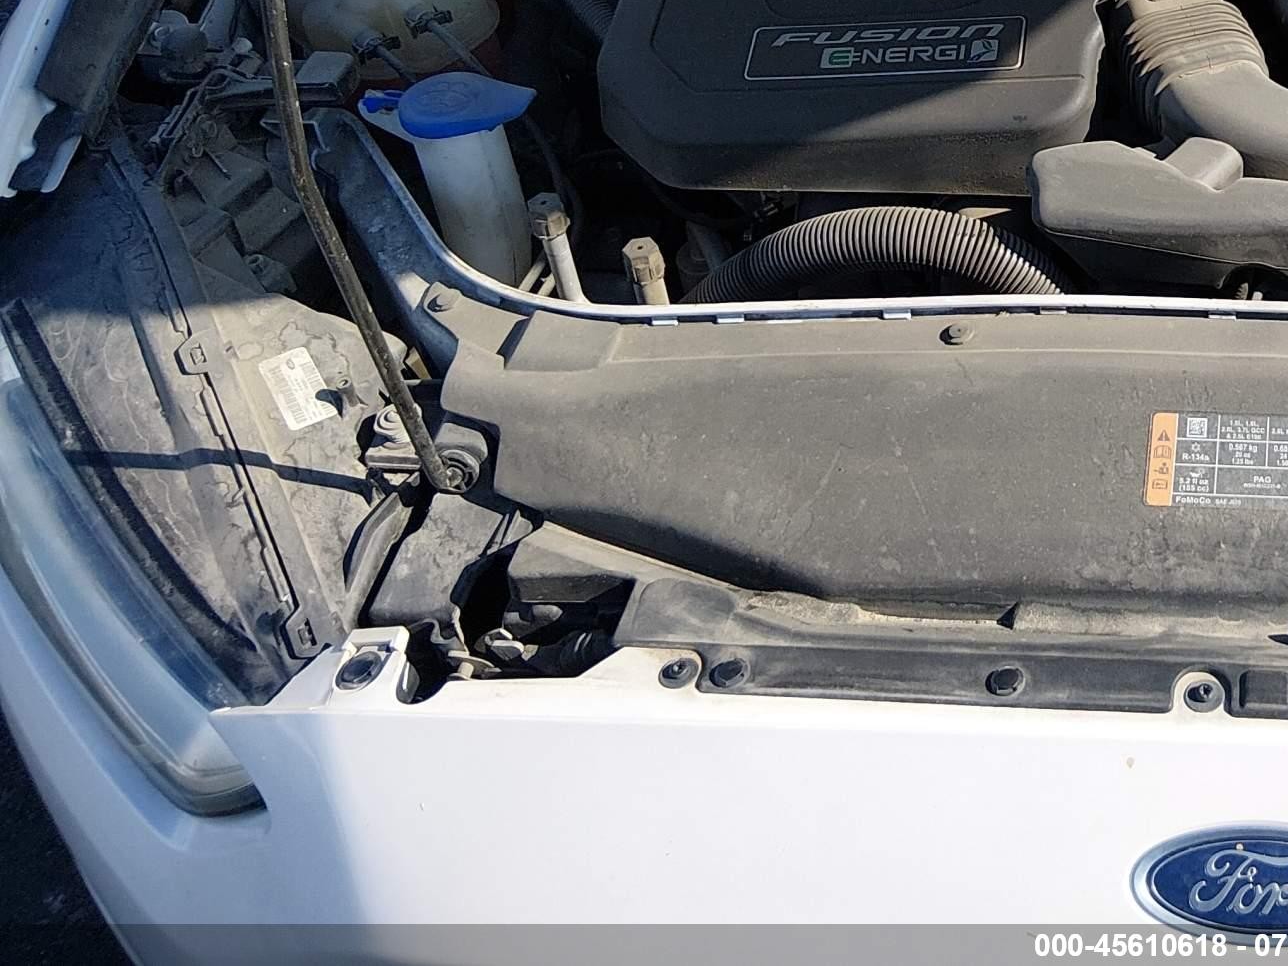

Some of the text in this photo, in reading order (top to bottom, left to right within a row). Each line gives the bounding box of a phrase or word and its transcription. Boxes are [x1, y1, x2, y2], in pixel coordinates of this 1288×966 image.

[770, 23, 1005, 48] FUSION
[1182, 452, 1210, 461] R-134a
[1253, 475, 1272, 483] PAG
[1175, 495, 1211, 504] FoMoCo
